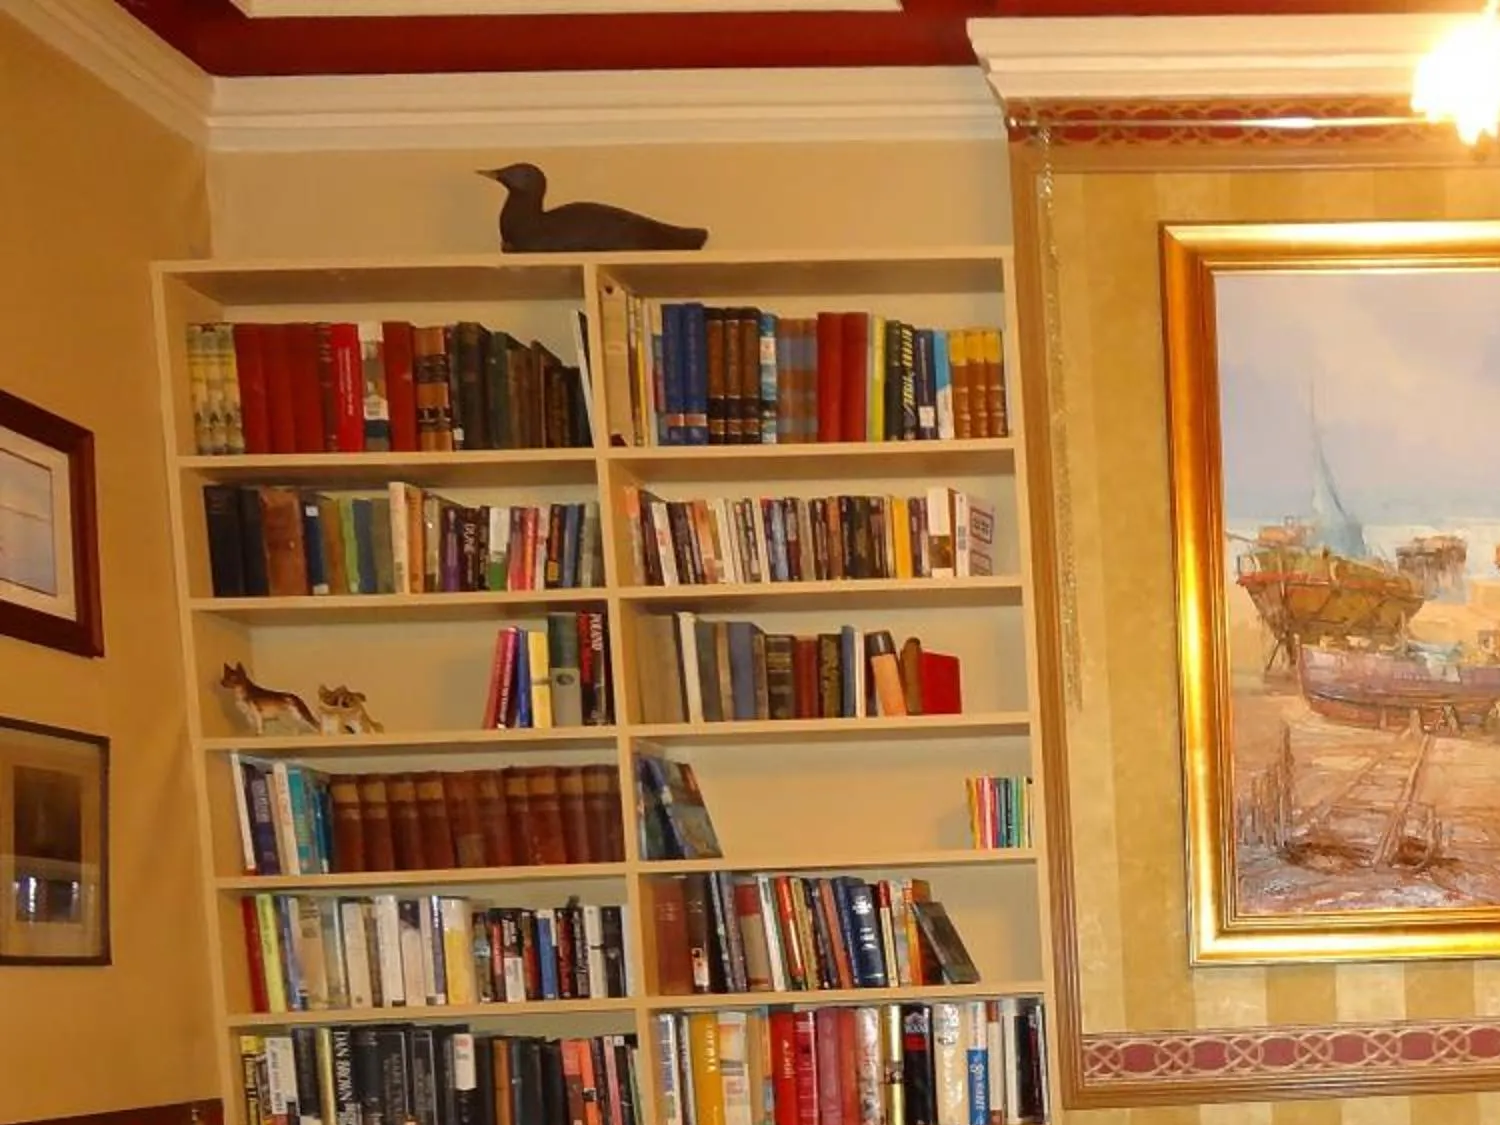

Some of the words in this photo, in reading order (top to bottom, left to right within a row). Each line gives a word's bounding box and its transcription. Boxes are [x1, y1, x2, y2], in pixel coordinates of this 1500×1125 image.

[589, 613, 605, 652] POLAND
[333, 1030, 351, 1057] DAN
[336, 1059, 354, 1102] BROWN
